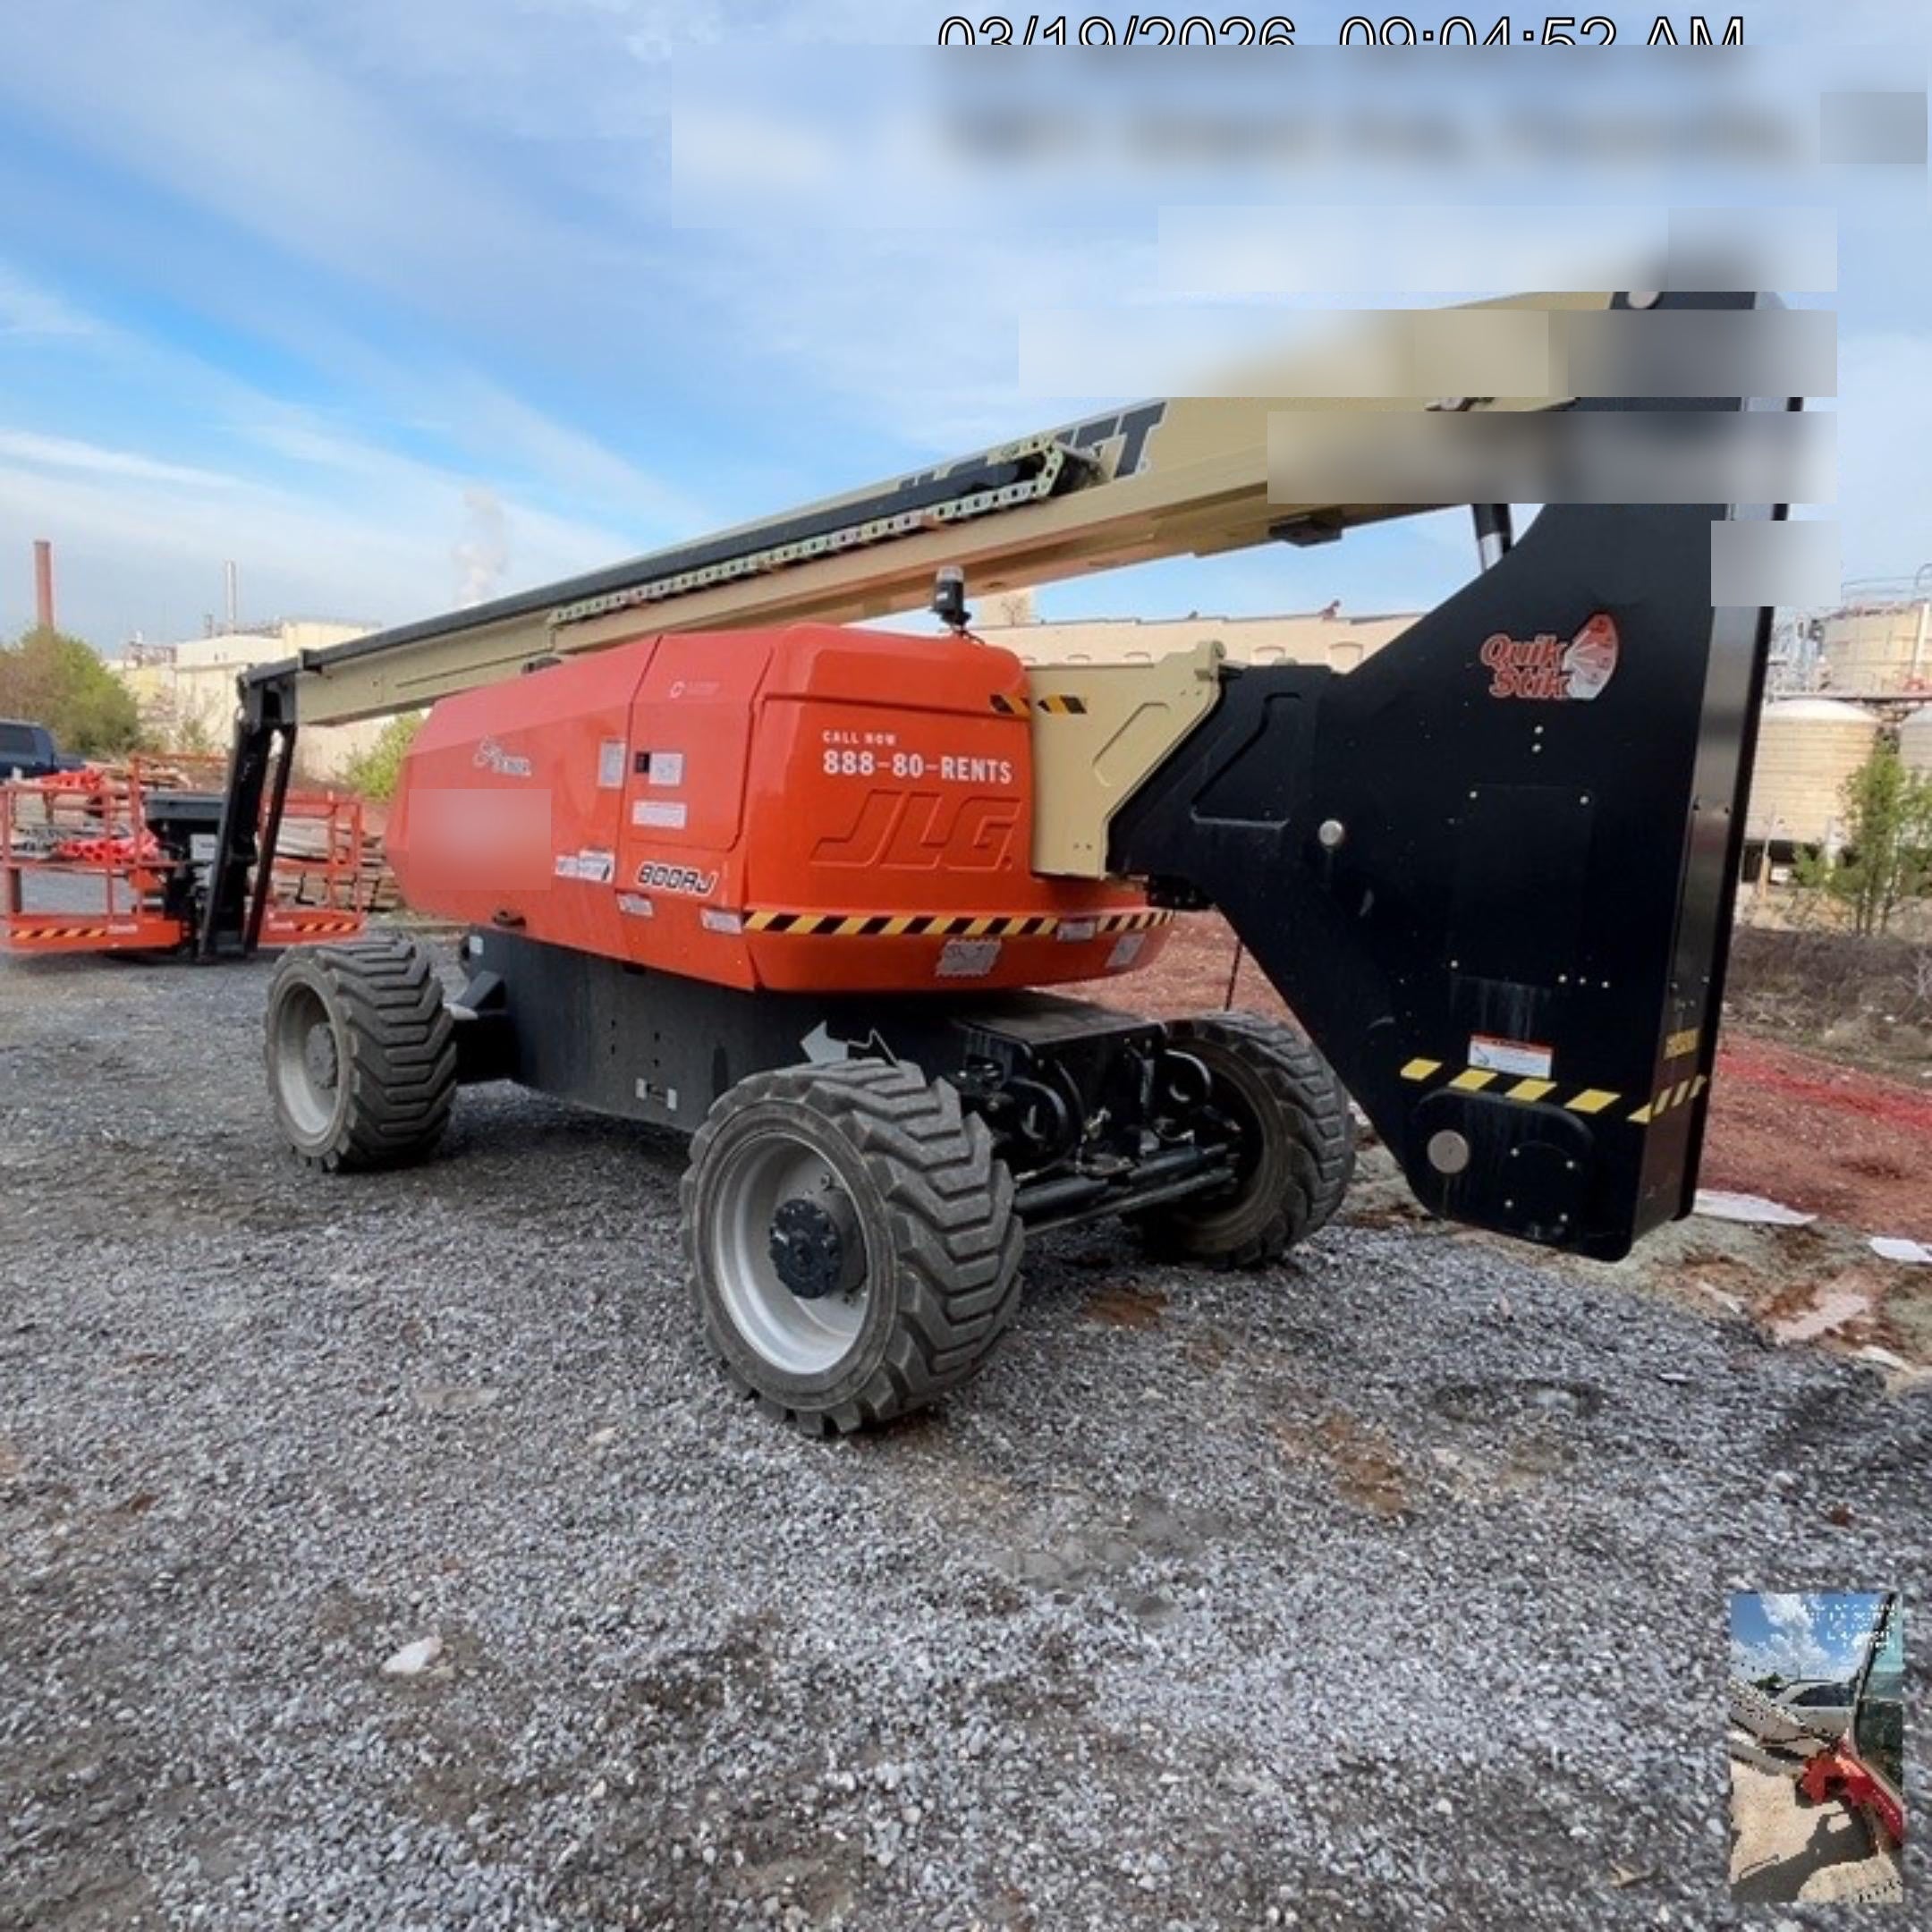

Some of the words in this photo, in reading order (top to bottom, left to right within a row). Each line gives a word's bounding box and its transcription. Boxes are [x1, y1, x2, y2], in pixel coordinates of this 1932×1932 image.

[822, 730, 860, 744] CALL
[864, 732, 896, 746] NOW
[823, 749, 1013, 784] 888-80-RENTS
[809, 789, 1022, 871] JLG
